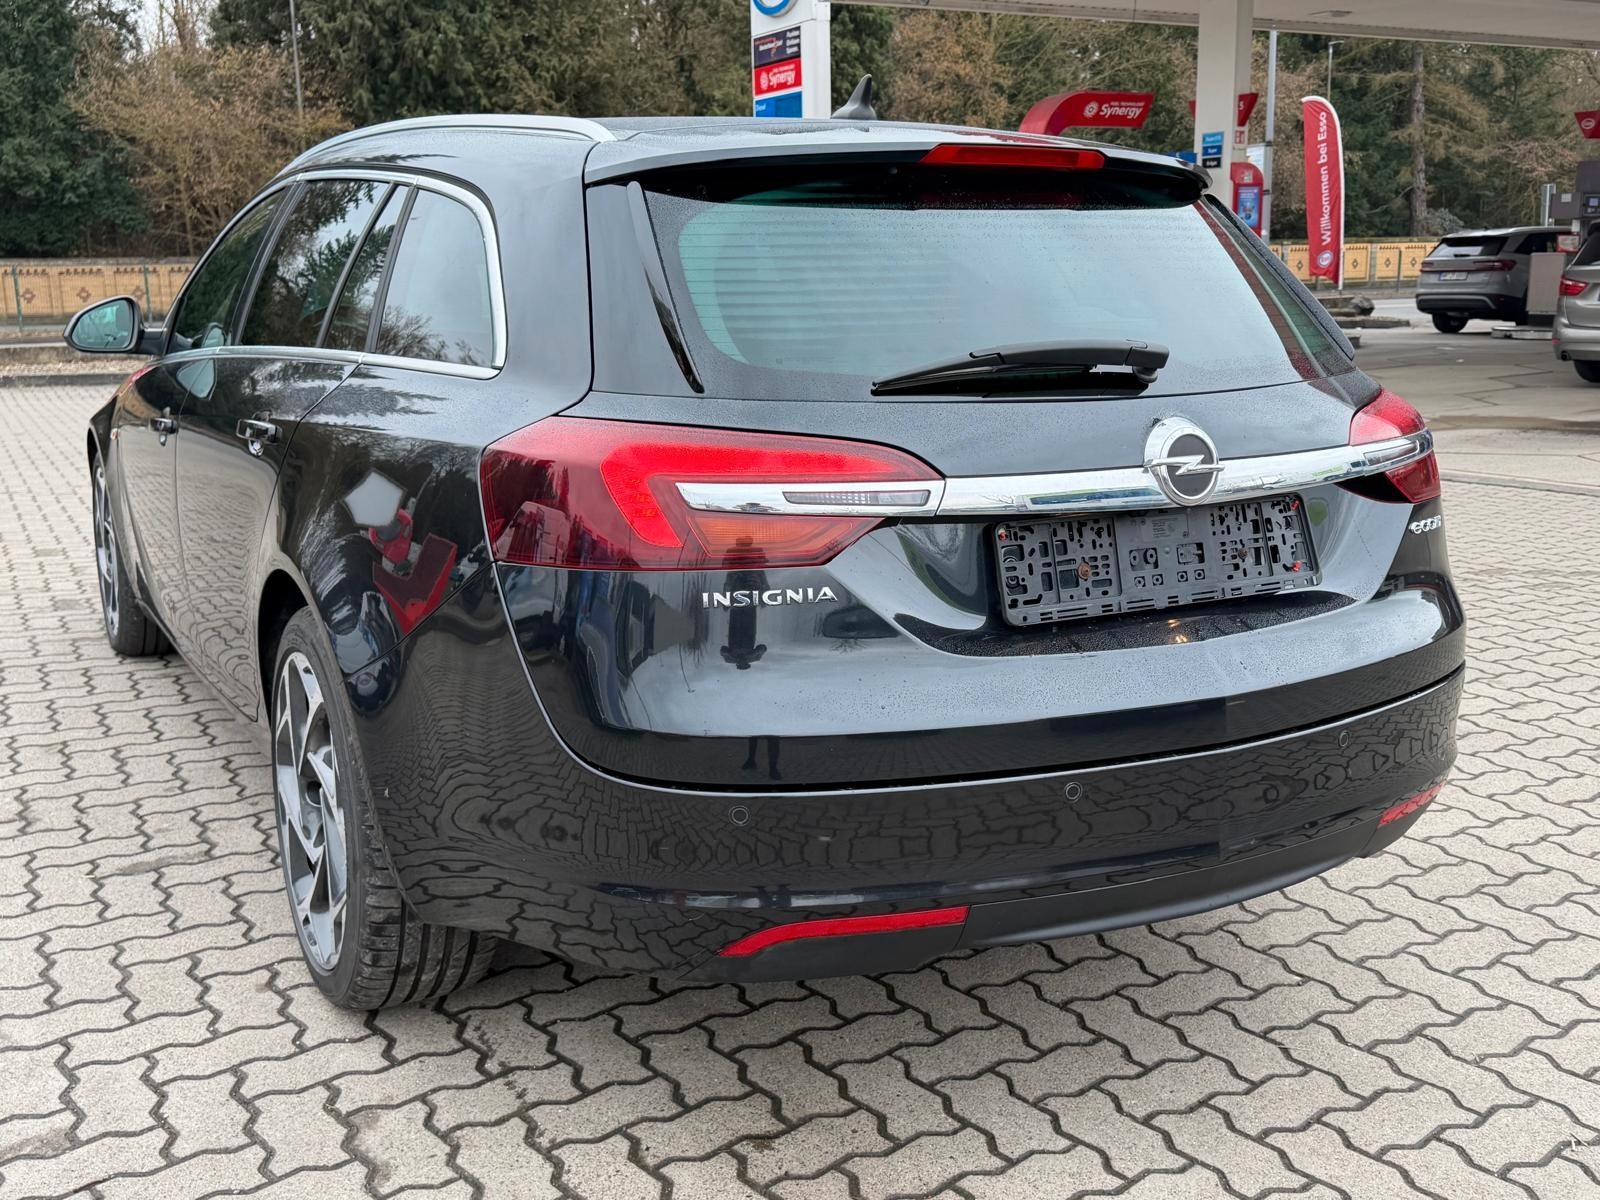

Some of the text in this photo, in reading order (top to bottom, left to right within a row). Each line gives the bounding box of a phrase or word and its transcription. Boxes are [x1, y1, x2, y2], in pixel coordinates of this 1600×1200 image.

[768, 70, 796, 89] Synergy
[1099, 104, 1143, 119] Synergy
[1317, 111, 1327, 140] Esso
[1317, 144, 1327, 164] bei
[1317, 166, 1331, 246] Willkommen
[702, 586, 838, 608] INSIGNIA
